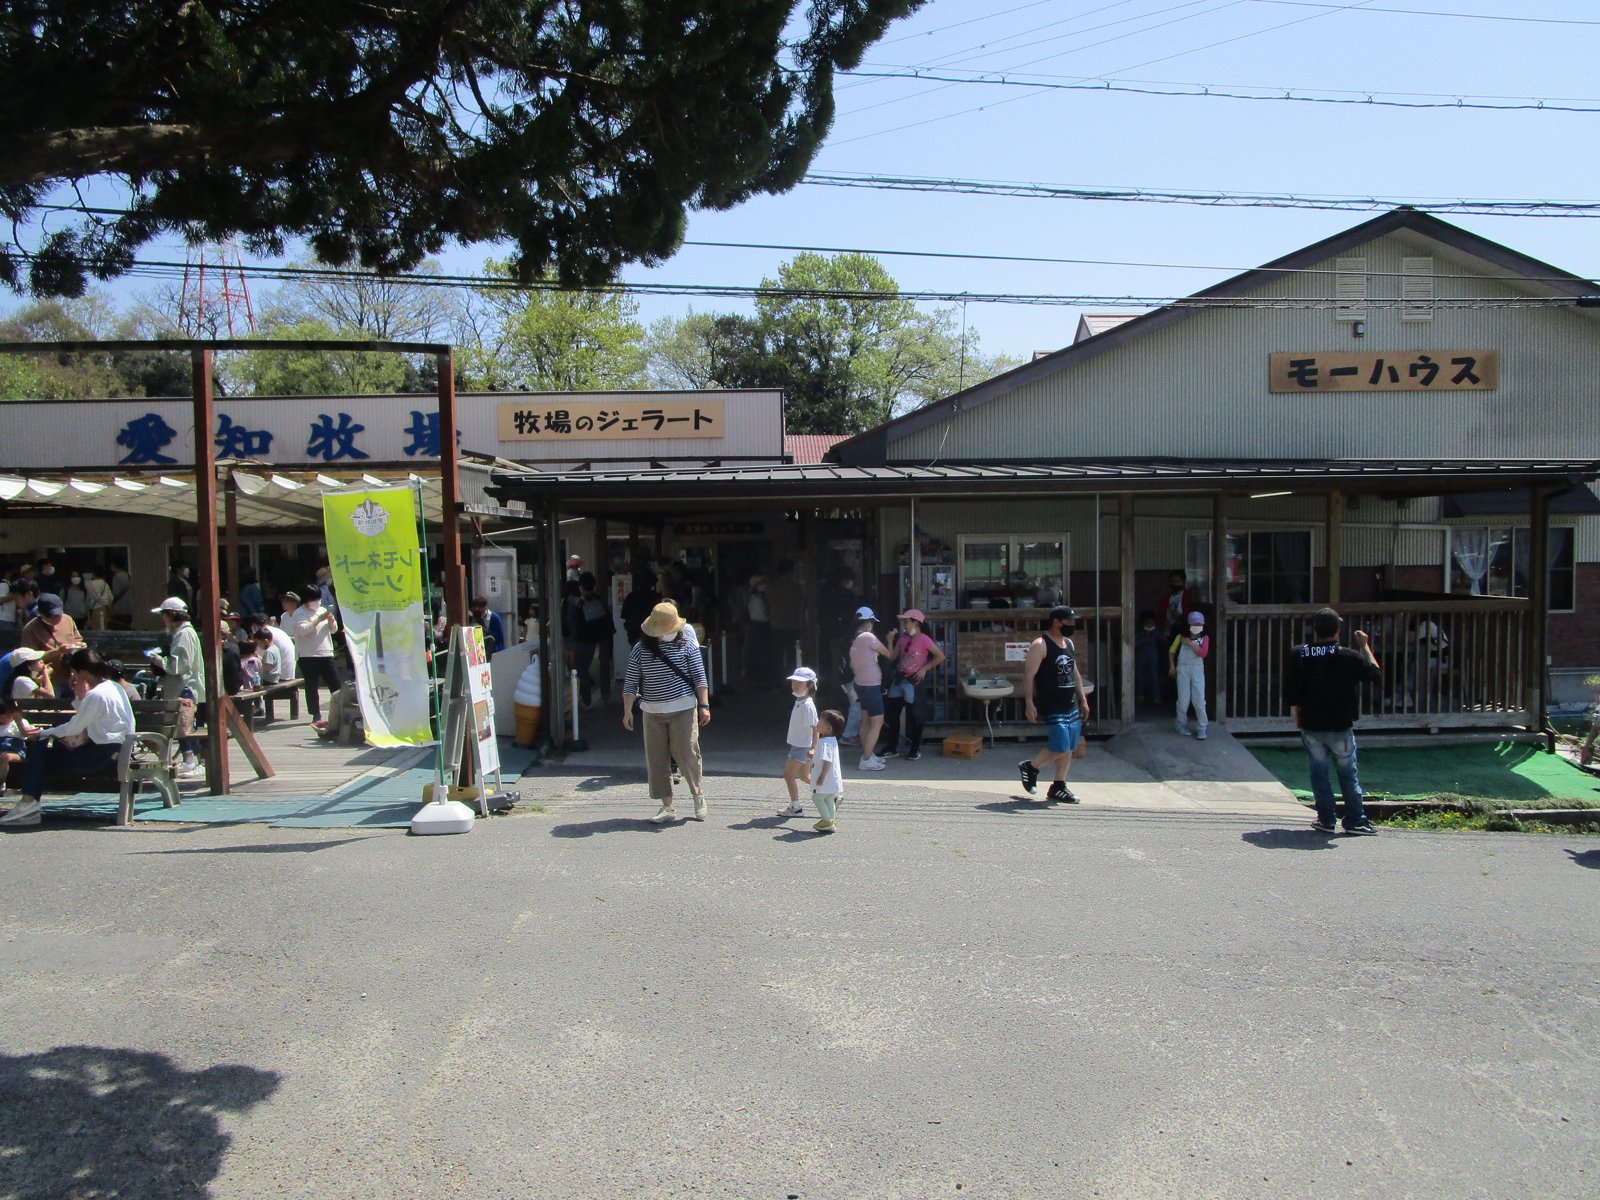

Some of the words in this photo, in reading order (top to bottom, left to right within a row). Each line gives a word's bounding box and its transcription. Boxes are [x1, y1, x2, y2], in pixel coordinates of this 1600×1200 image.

[1287, 354, 1481, 388] モーハウス
[513, 408, 713, 435] 牧場のジェラート
